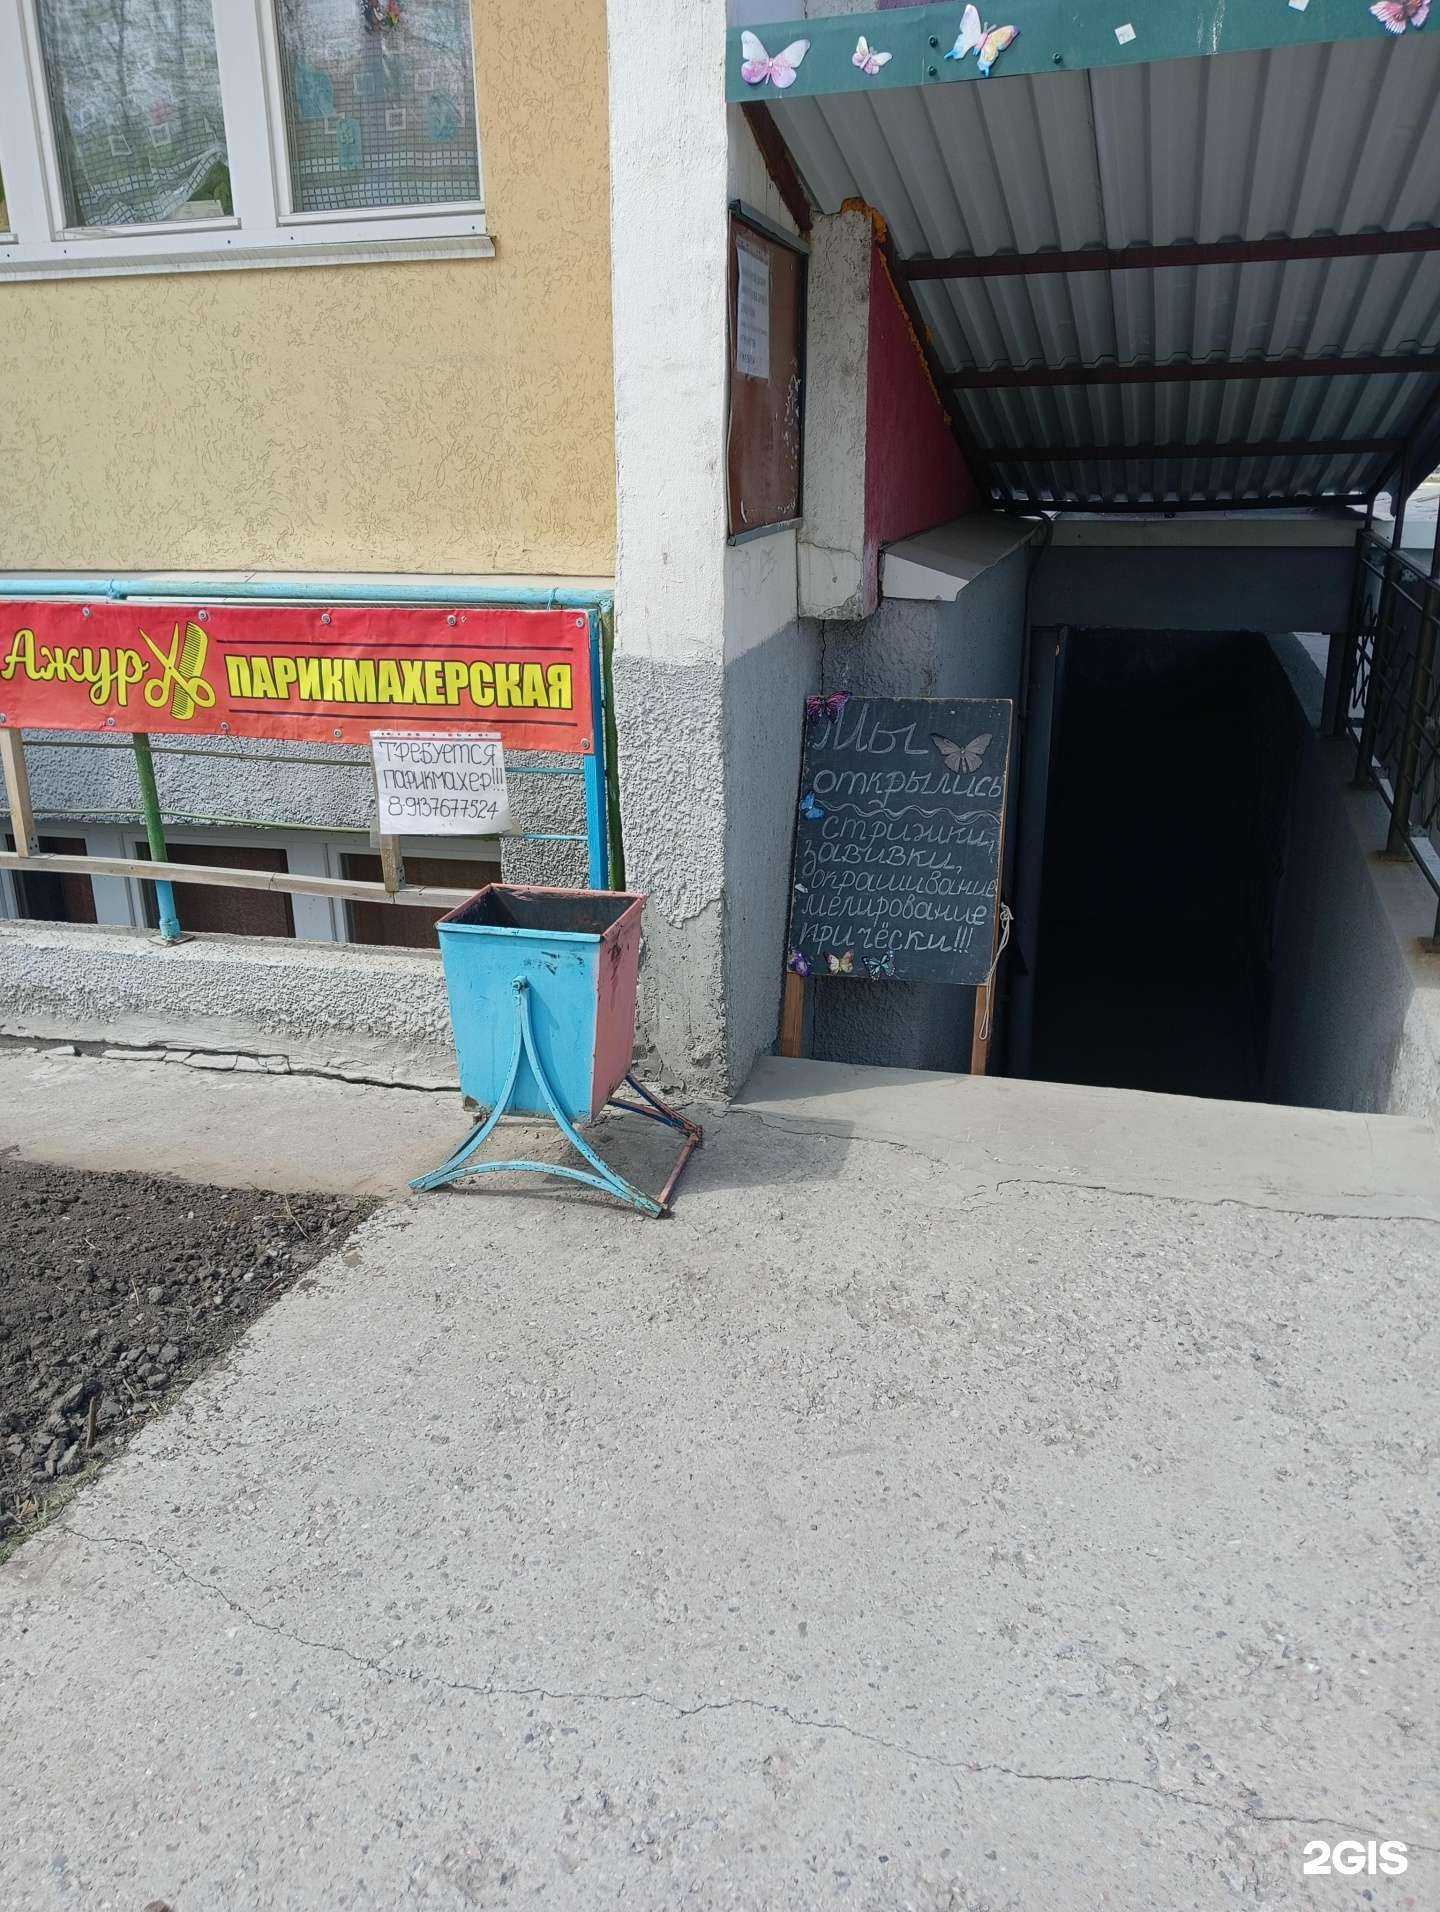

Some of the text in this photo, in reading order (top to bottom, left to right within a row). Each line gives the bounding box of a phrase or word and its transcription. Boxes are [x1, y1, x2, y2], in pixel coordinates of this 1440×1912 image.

[0, 628, 149, 706] Ажур
[223, 654, 573, 710] ПАРИКМАХЕРСКАЯ
[811, 702, 928, 755] Мы
[813, 769, 1001, 809] открылись
